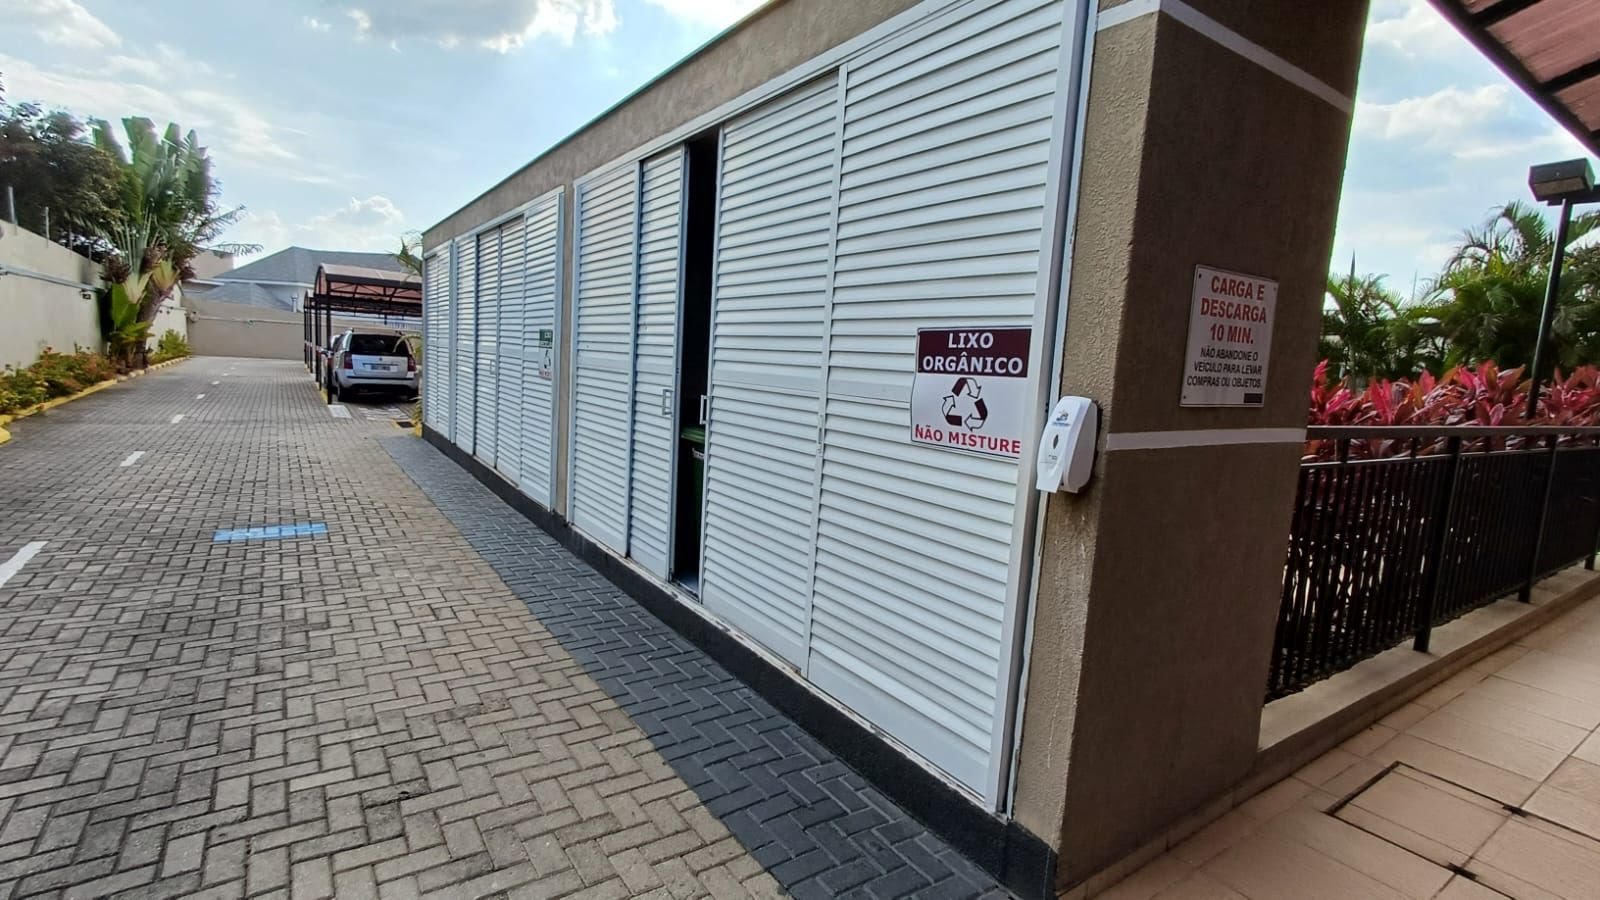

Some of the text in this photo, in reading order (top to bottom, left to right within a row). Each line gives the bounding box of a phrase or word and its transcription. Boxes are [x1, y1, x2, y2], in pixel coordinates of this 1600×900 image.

[1211, 276, 1265, 301] CARGA E
[1200, 298, 1267, 323] DESCARGA
[948, 332, 994, 349] LIXO
[1210, 323, 1254, 344] 10 MIN.
[922, 352, 1023, 374] ORGÂNICO
[1200, 345, 1259, 361] NÃO ABANDONE O
[1223, 363, 1241, 374] PARA
[1241, 364, 1263, 375] LEVAR
[1186, 376, 1220, 387] COMPRAS
[1221, 377, 1231, 387] OU
[915, 424, 1021, 454] NÃO MISTURE
